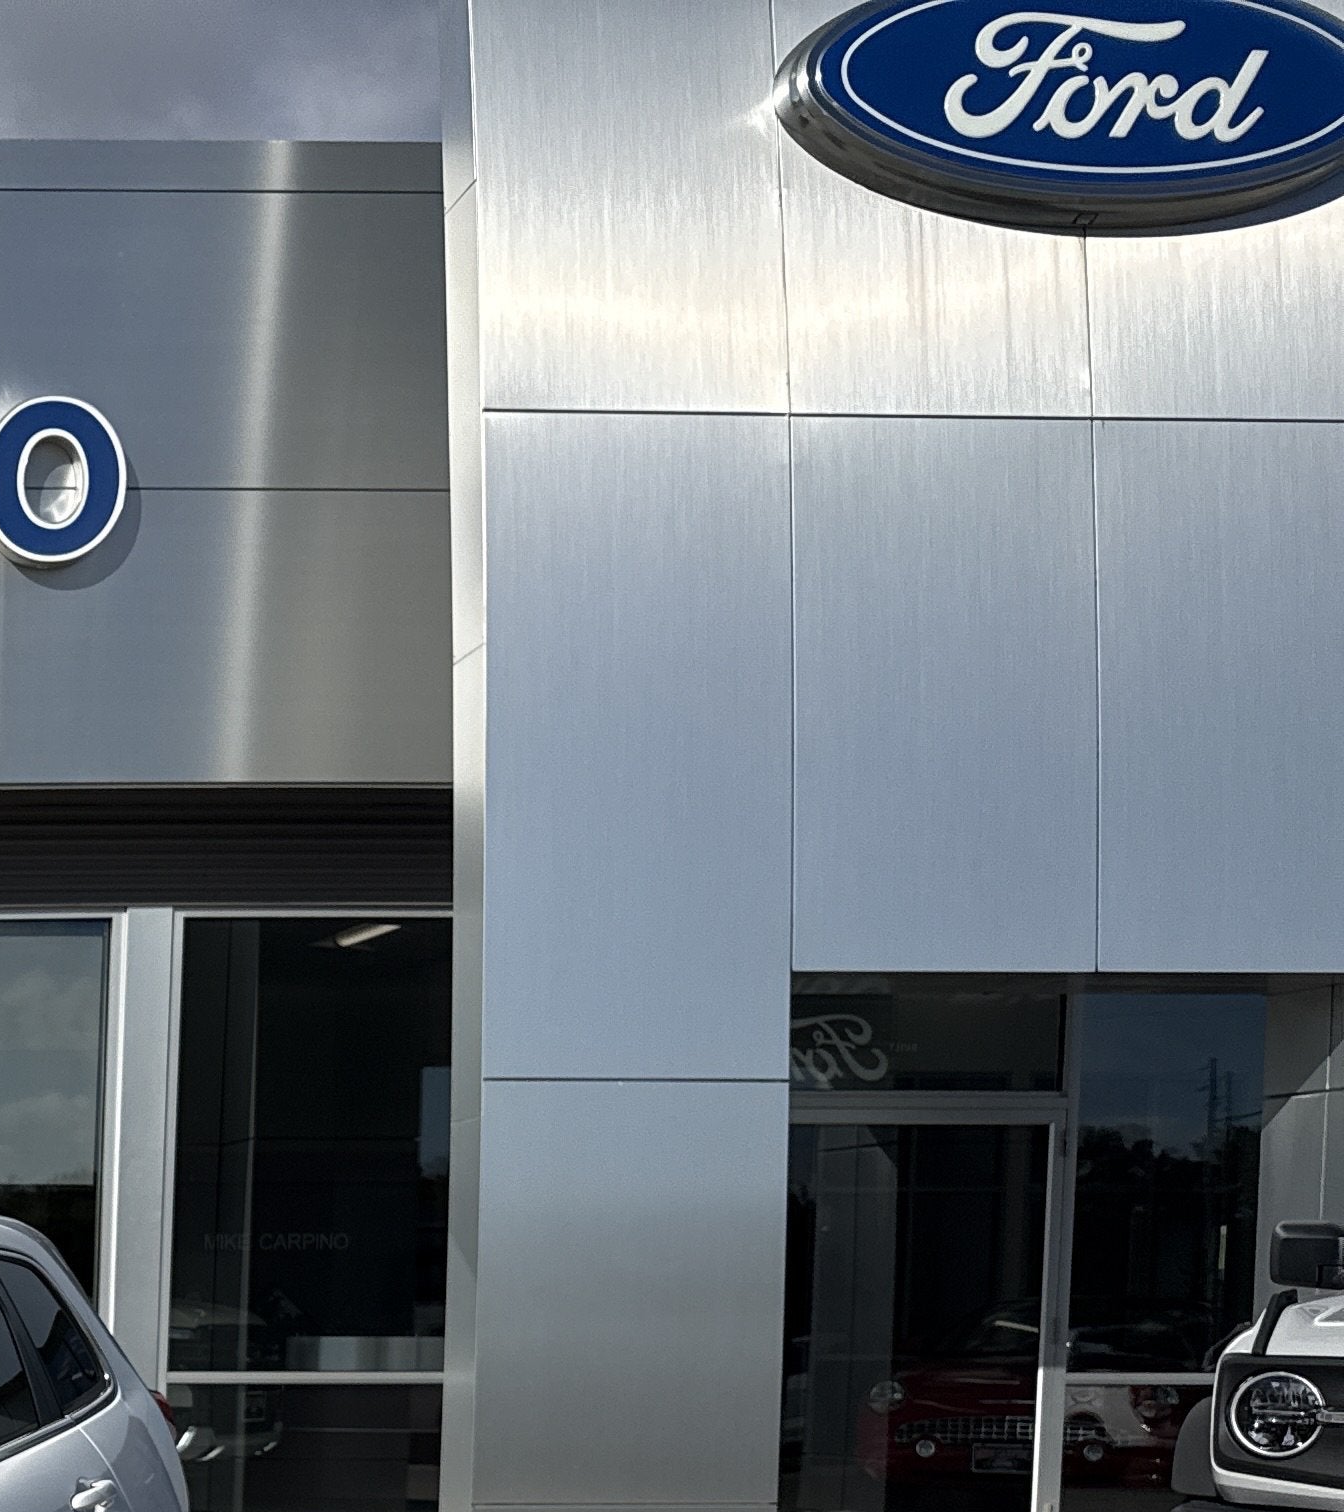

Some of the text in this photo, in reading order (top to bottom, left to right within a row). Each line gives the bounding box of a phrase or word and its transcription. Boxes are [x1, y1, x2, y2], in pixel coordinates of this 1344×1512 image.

[944, 11, 1269, 143] Ford
[203, 1232, 349, 1251] MIKE CARPINO
